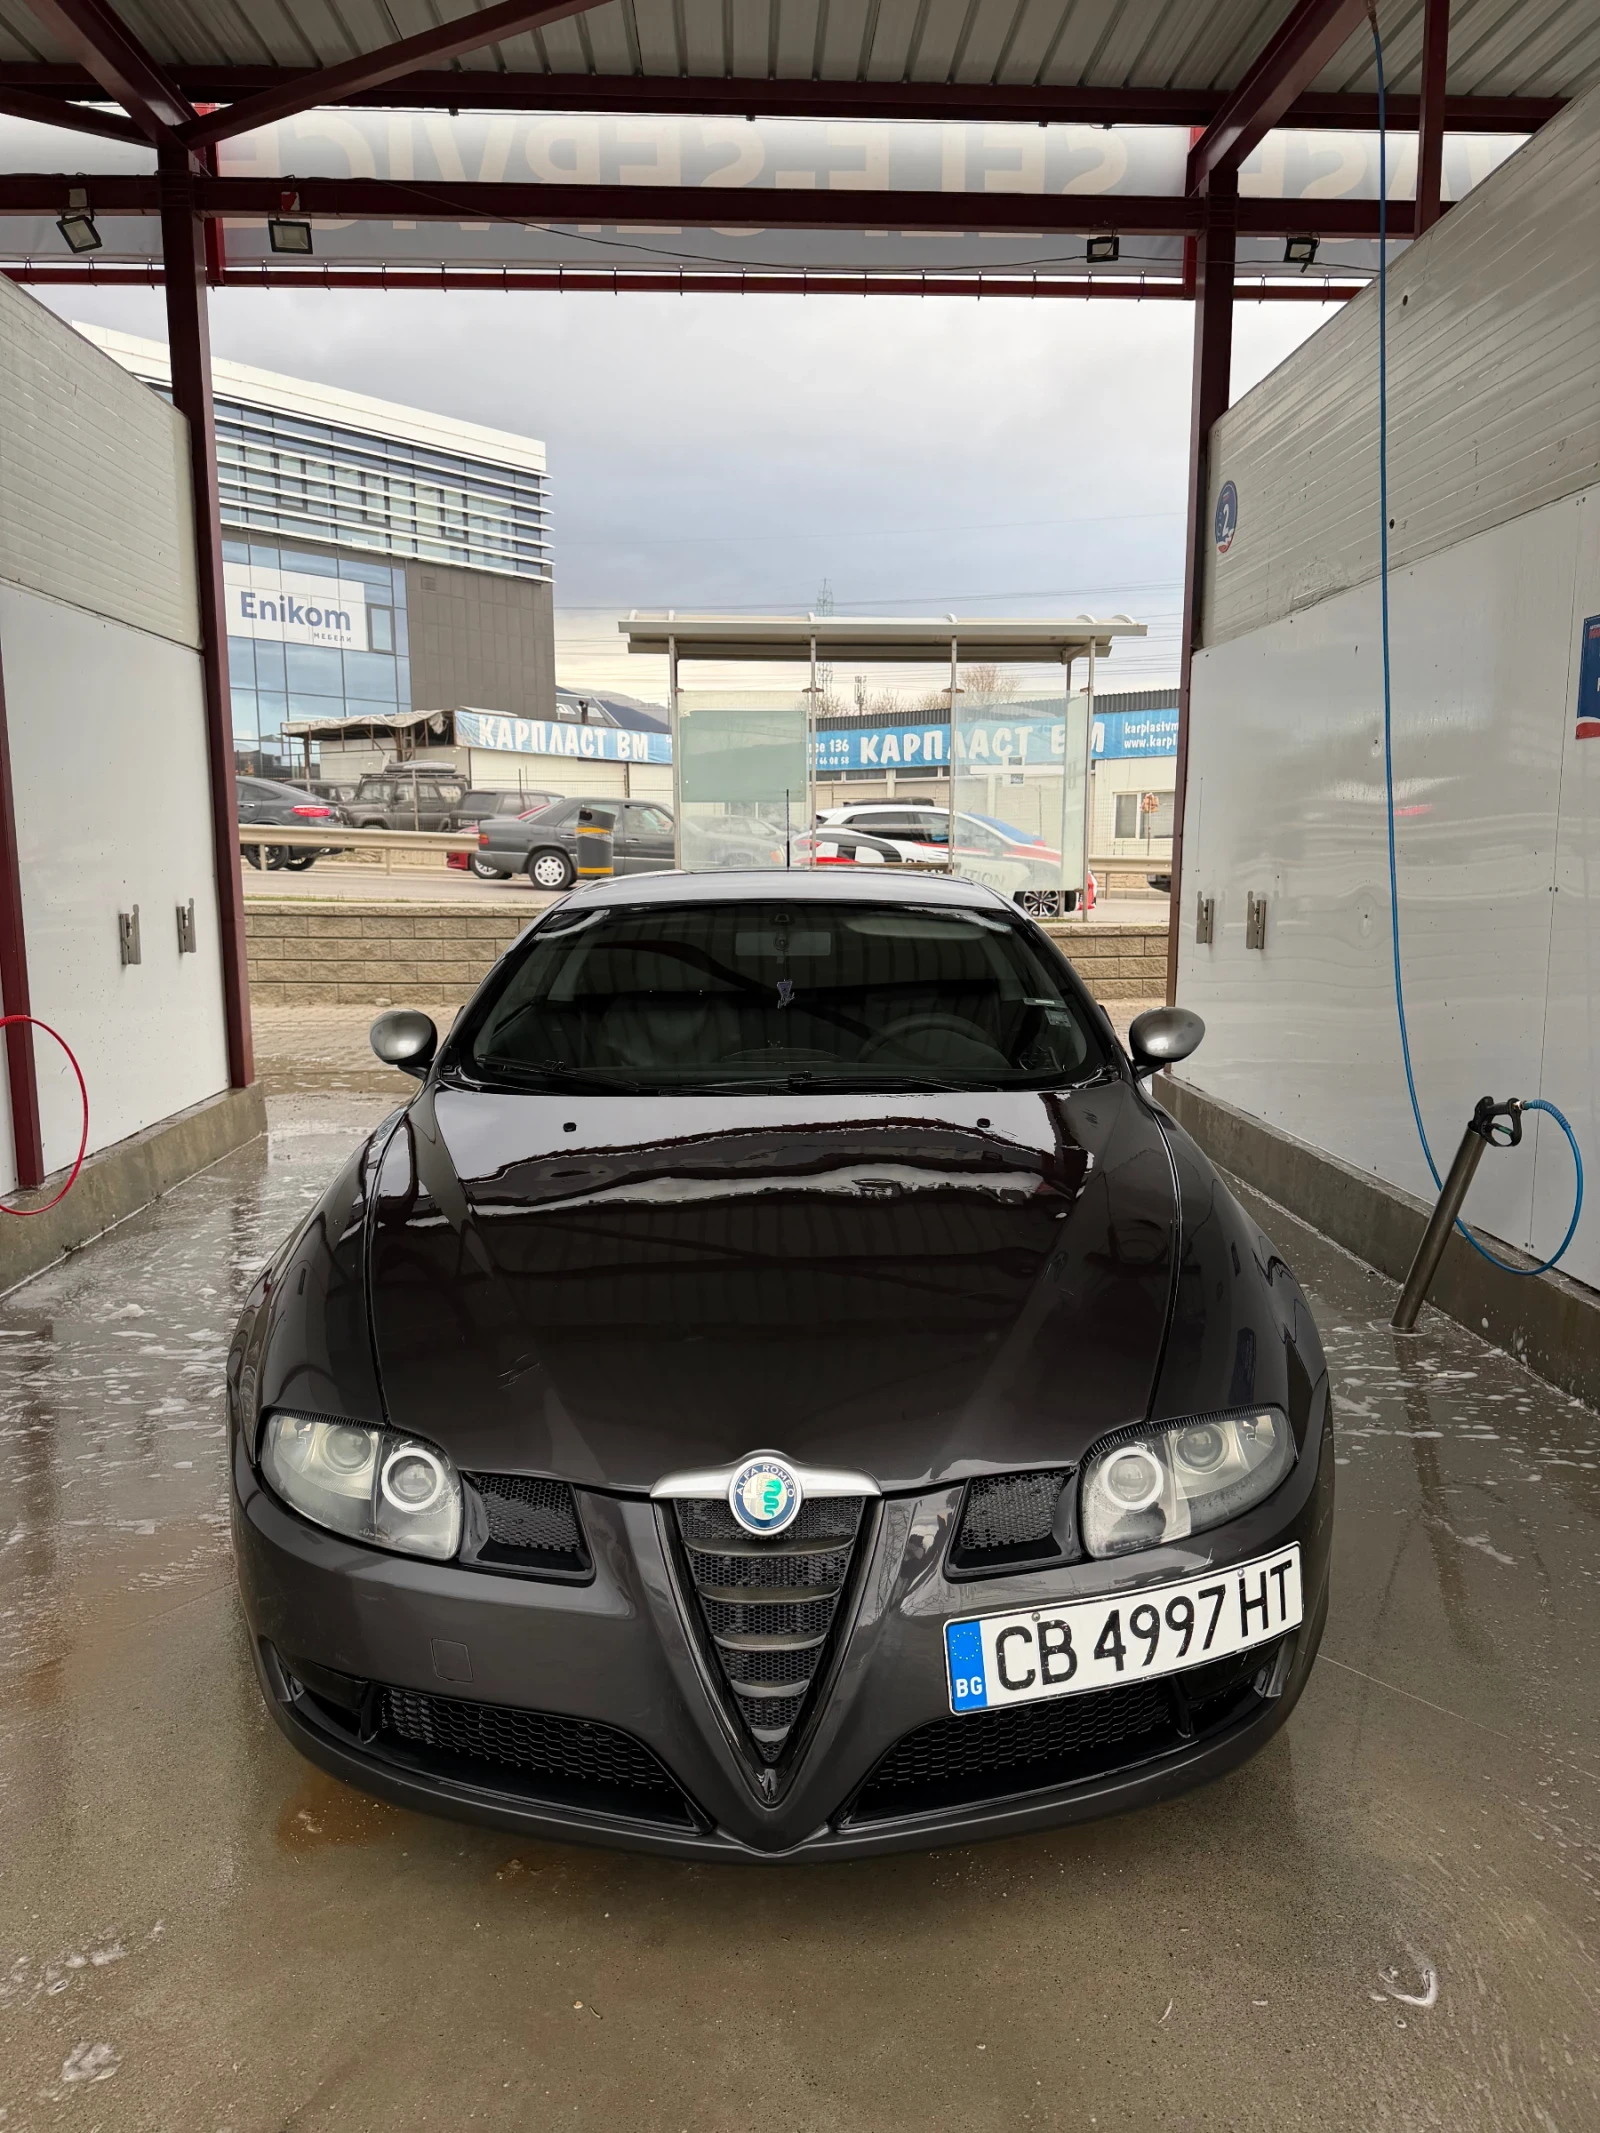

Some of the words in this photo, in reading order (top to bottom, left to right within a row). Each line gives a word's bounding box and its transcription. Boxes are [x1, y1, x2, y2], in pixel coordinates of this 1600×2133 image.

[240, 590, 351, 631] Enikom
[479, 714, 607, 757] КАРПЛАСТ
[617, 731, 649, 760] ВМ
[829, 738, 850, 753] 136
[860, 726, 1034, 764] КАРПЛАСТ
[736, 1467, 759, 1496] ALFA
[762, 1464, 795, 1498] ROMEO
[995, 1619, 1078, 1691] CB
[1093, 1583, 1226, 1672] 4997
[1238, 1559, 1293, 1638] HT
[955, 1678, 983, 1699] BG
